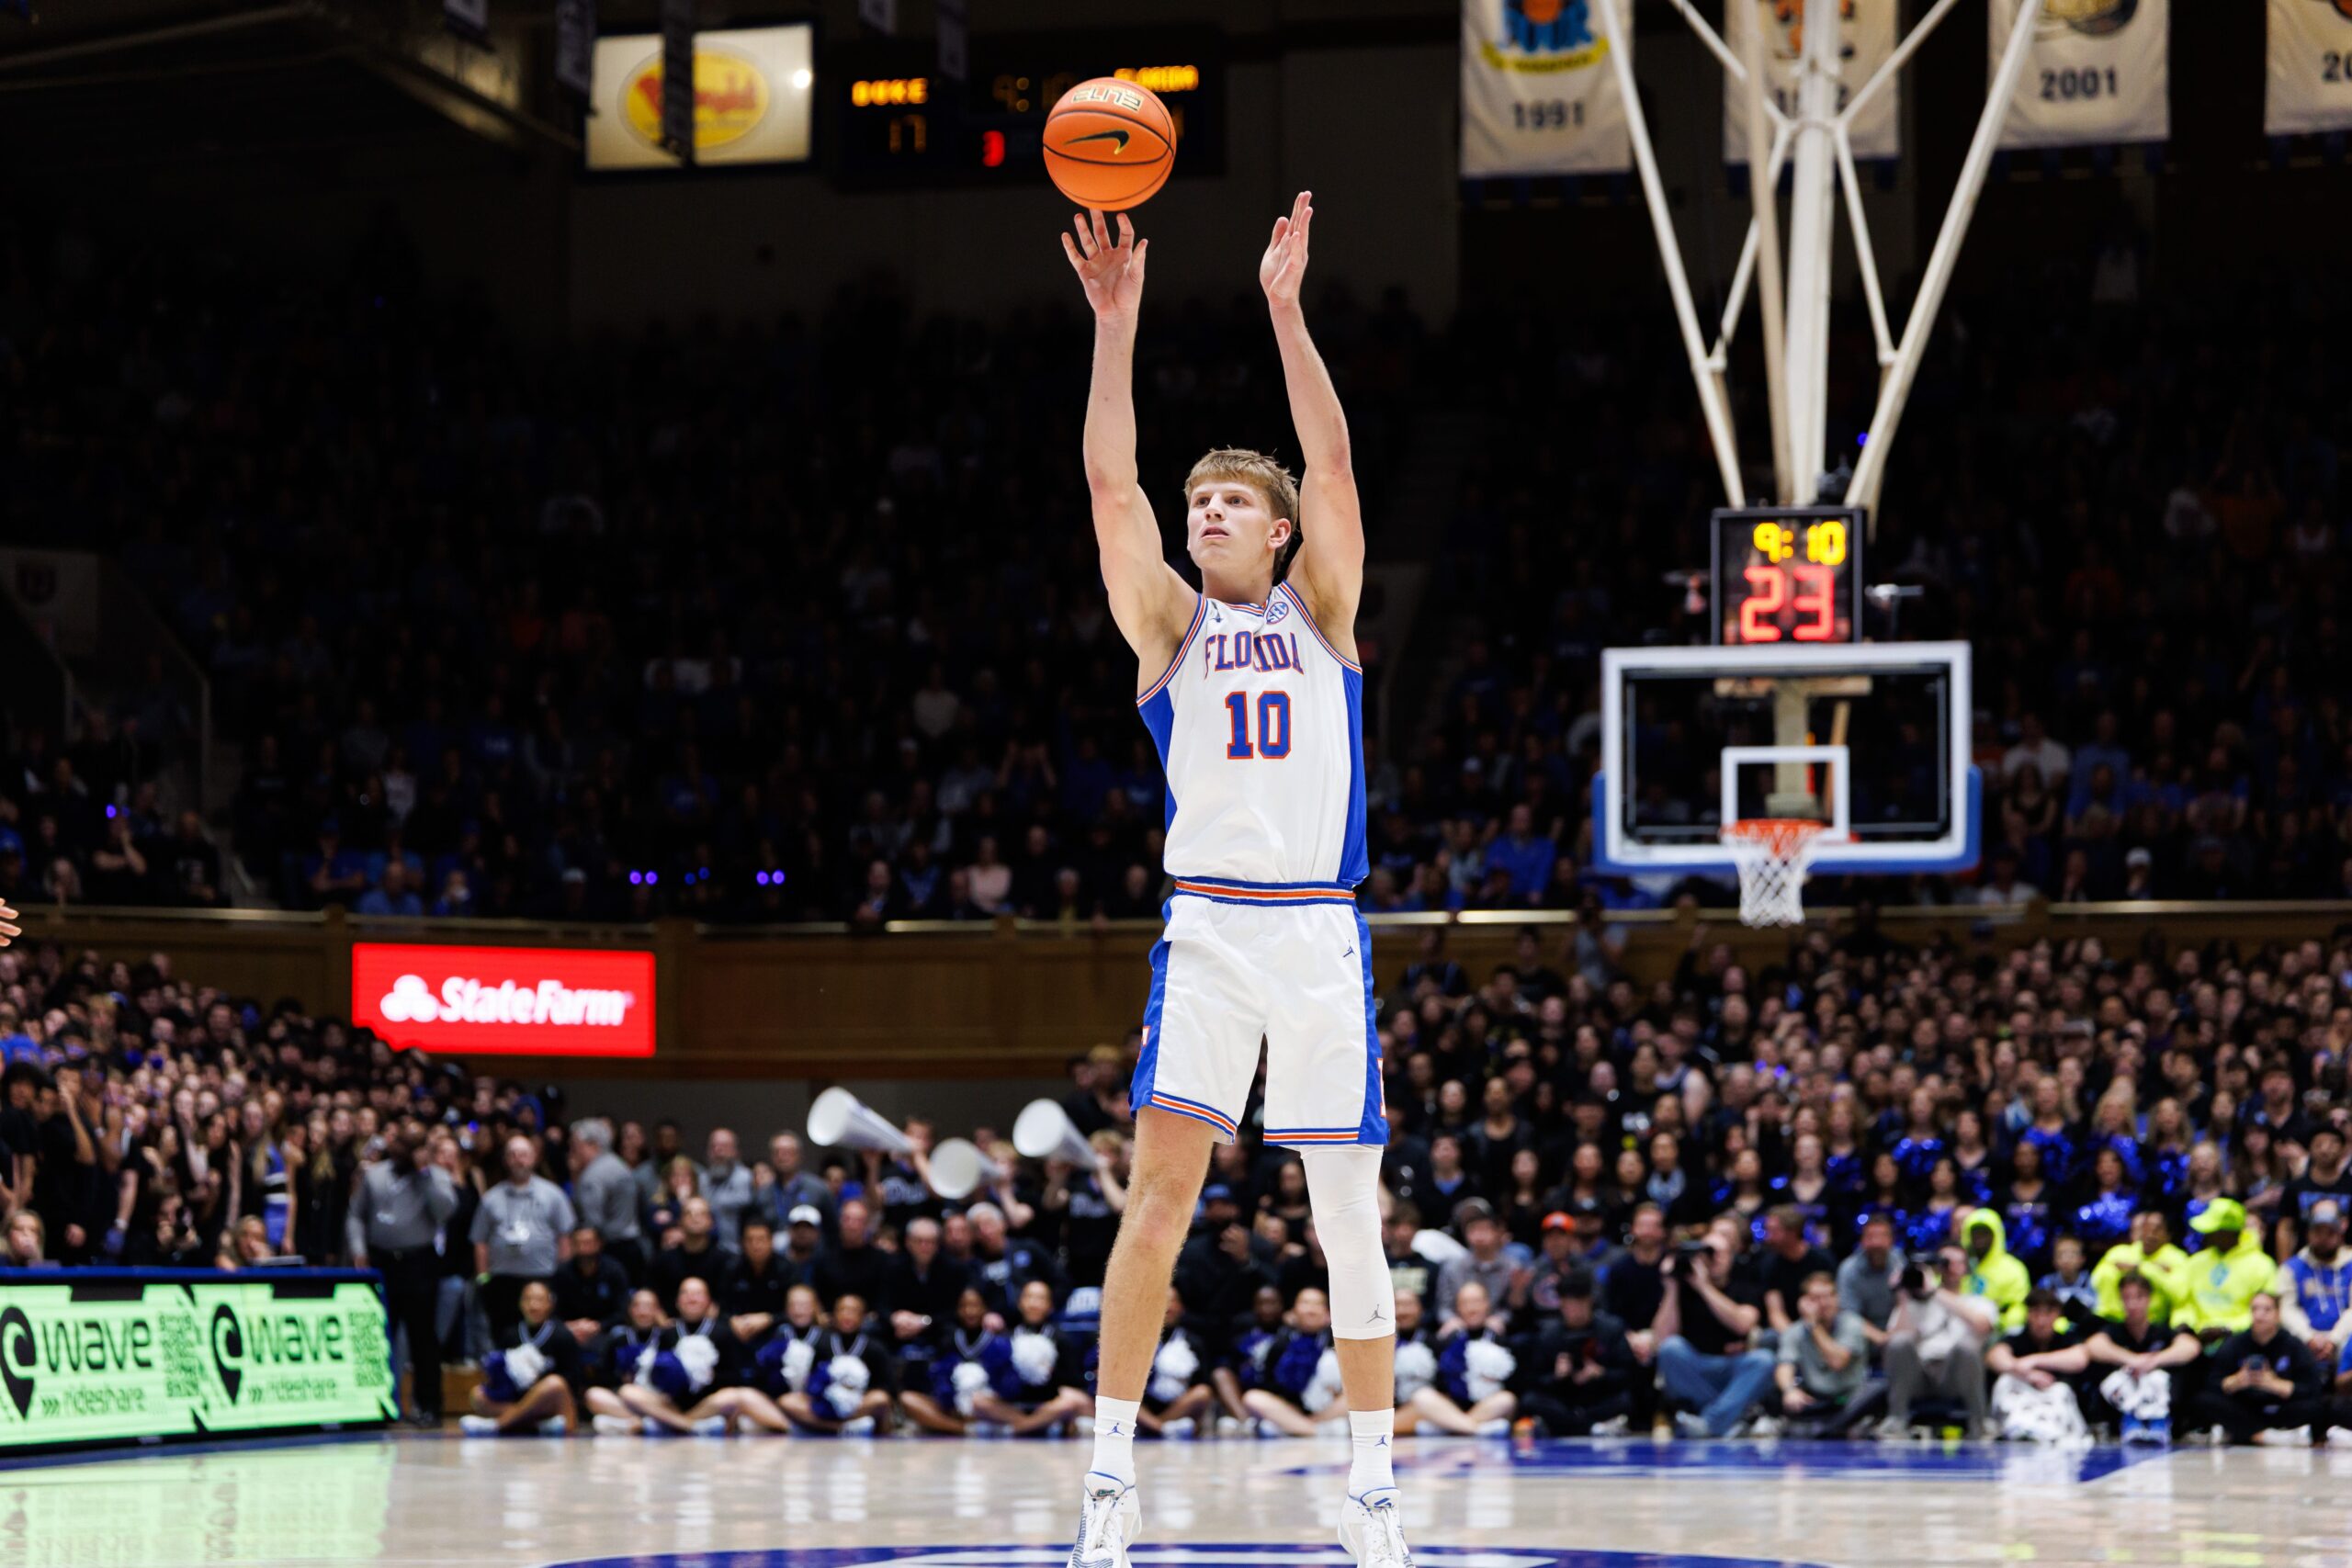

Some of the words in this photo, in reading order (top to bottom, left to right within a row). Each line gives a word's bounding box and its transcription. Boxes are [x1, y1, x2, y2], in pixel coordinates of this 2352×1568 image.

[1070, 84, 1144, 113] ELITE
[2041, 66, 2118, 101] 2001
[1514, 100, 1584, 130] 1991
[1753, 521, 1846, 565] 9:10
[1740, 566, 1835, 641] 23
[1204, 630, 1305, 680] FLOIDA
[1225, 690, 1291, 760] 10
[42, 1319, 153, 1372] wave
[247, 1314, 344, 1364] wave
